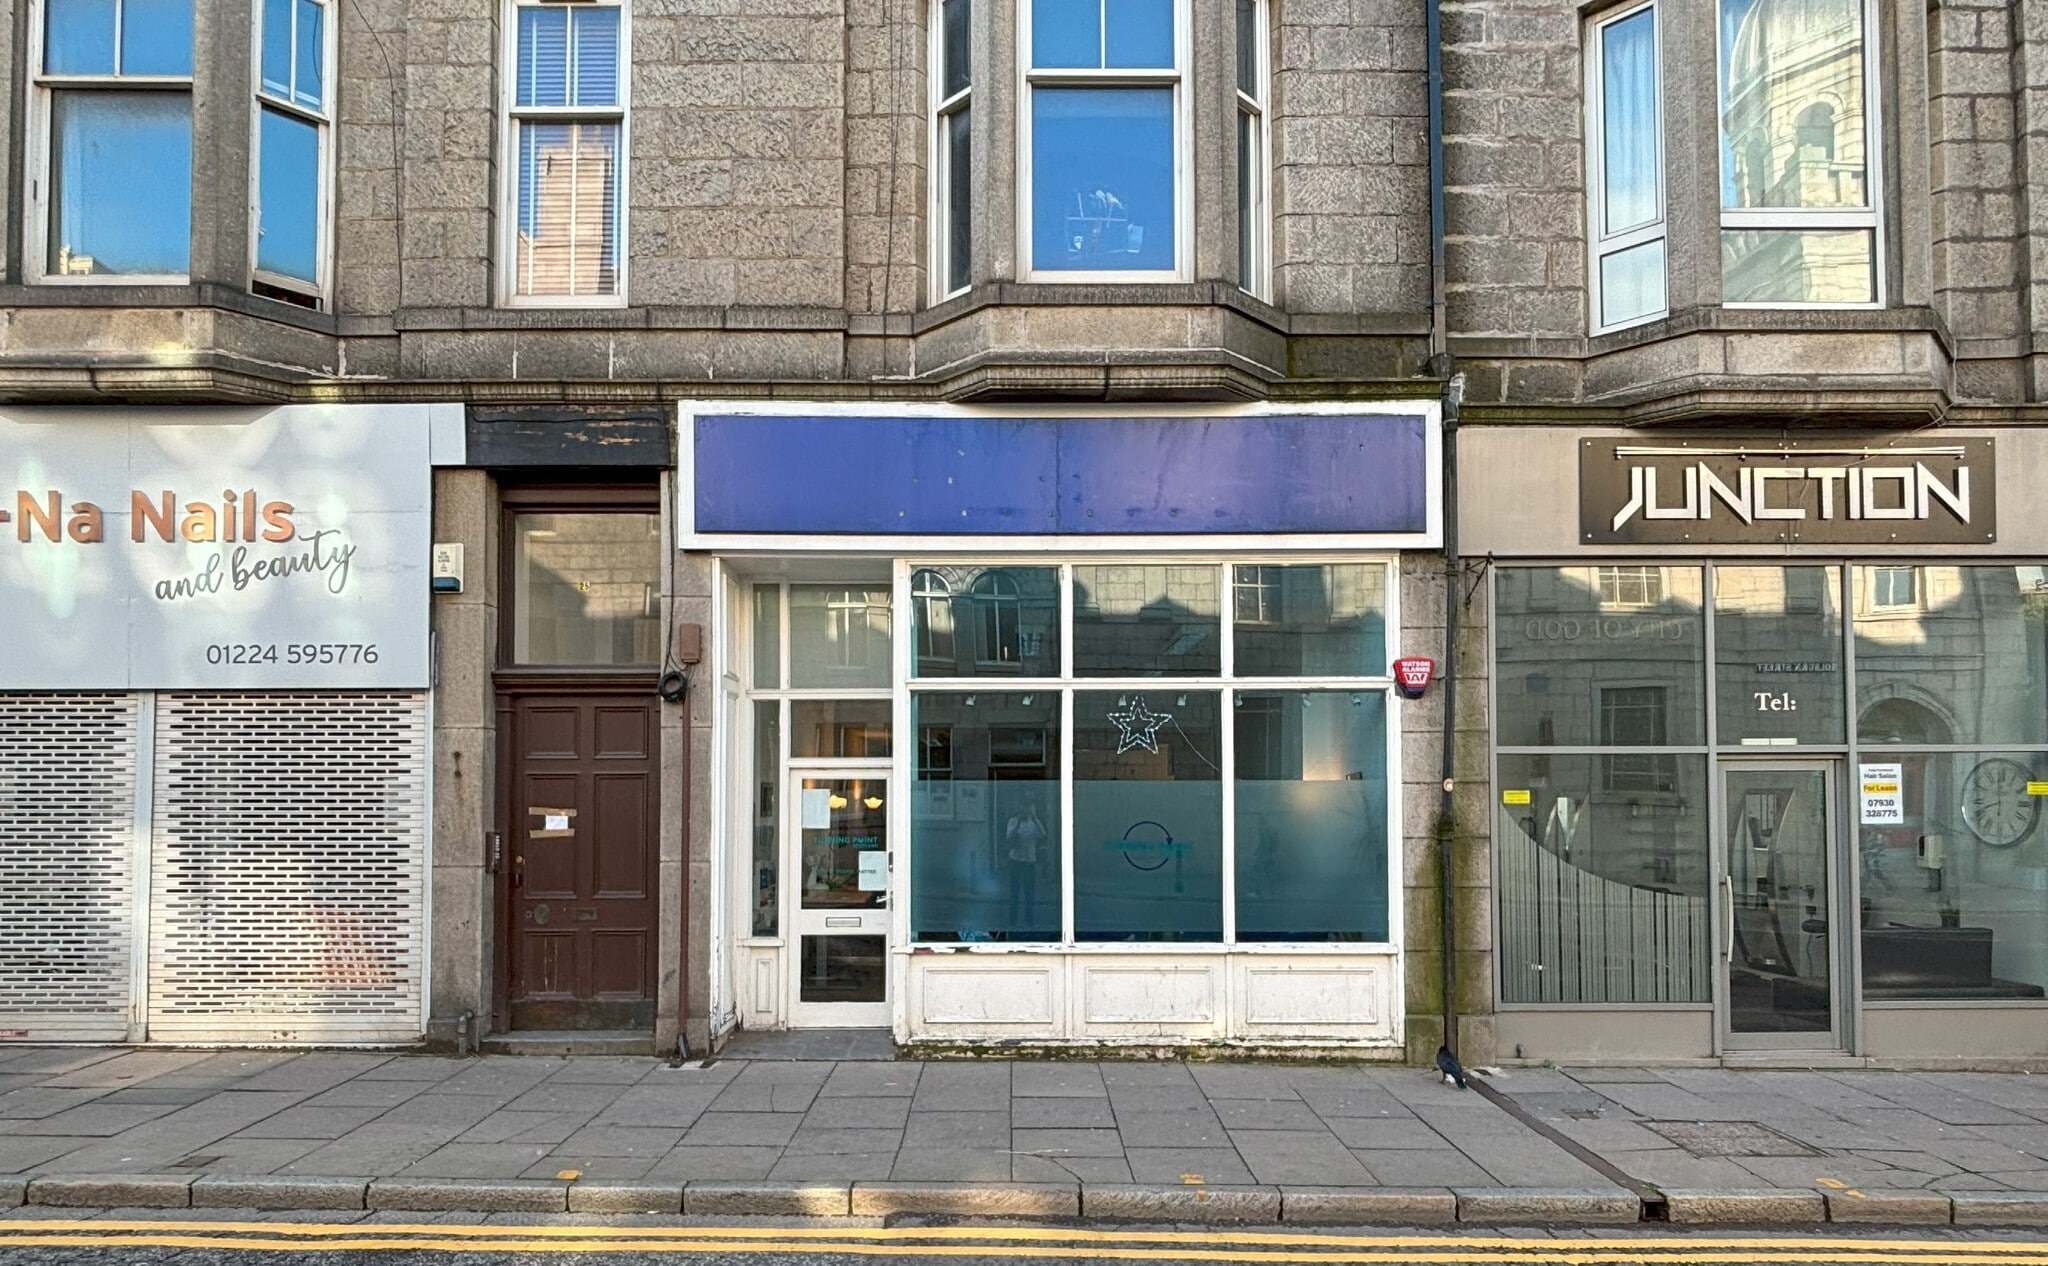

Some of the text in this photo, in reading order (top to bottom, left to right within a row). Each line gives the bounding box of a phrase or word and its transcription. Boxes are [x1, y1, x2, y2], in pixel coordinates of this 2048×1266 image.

[1612, 461, 1970, 532] JUNCTION
[131, 488, 296, 544] Nails
[155, 529, 357, 601] and beauty
[206, 644, 379, 664] 01224 595776
[1753, 692, 1797, 711] Tel:
[1863, 784, 1898, 792] For Lease
[1867, 799, 1895, 807] 07930
[1865, 809, 1898, 817] 328775
